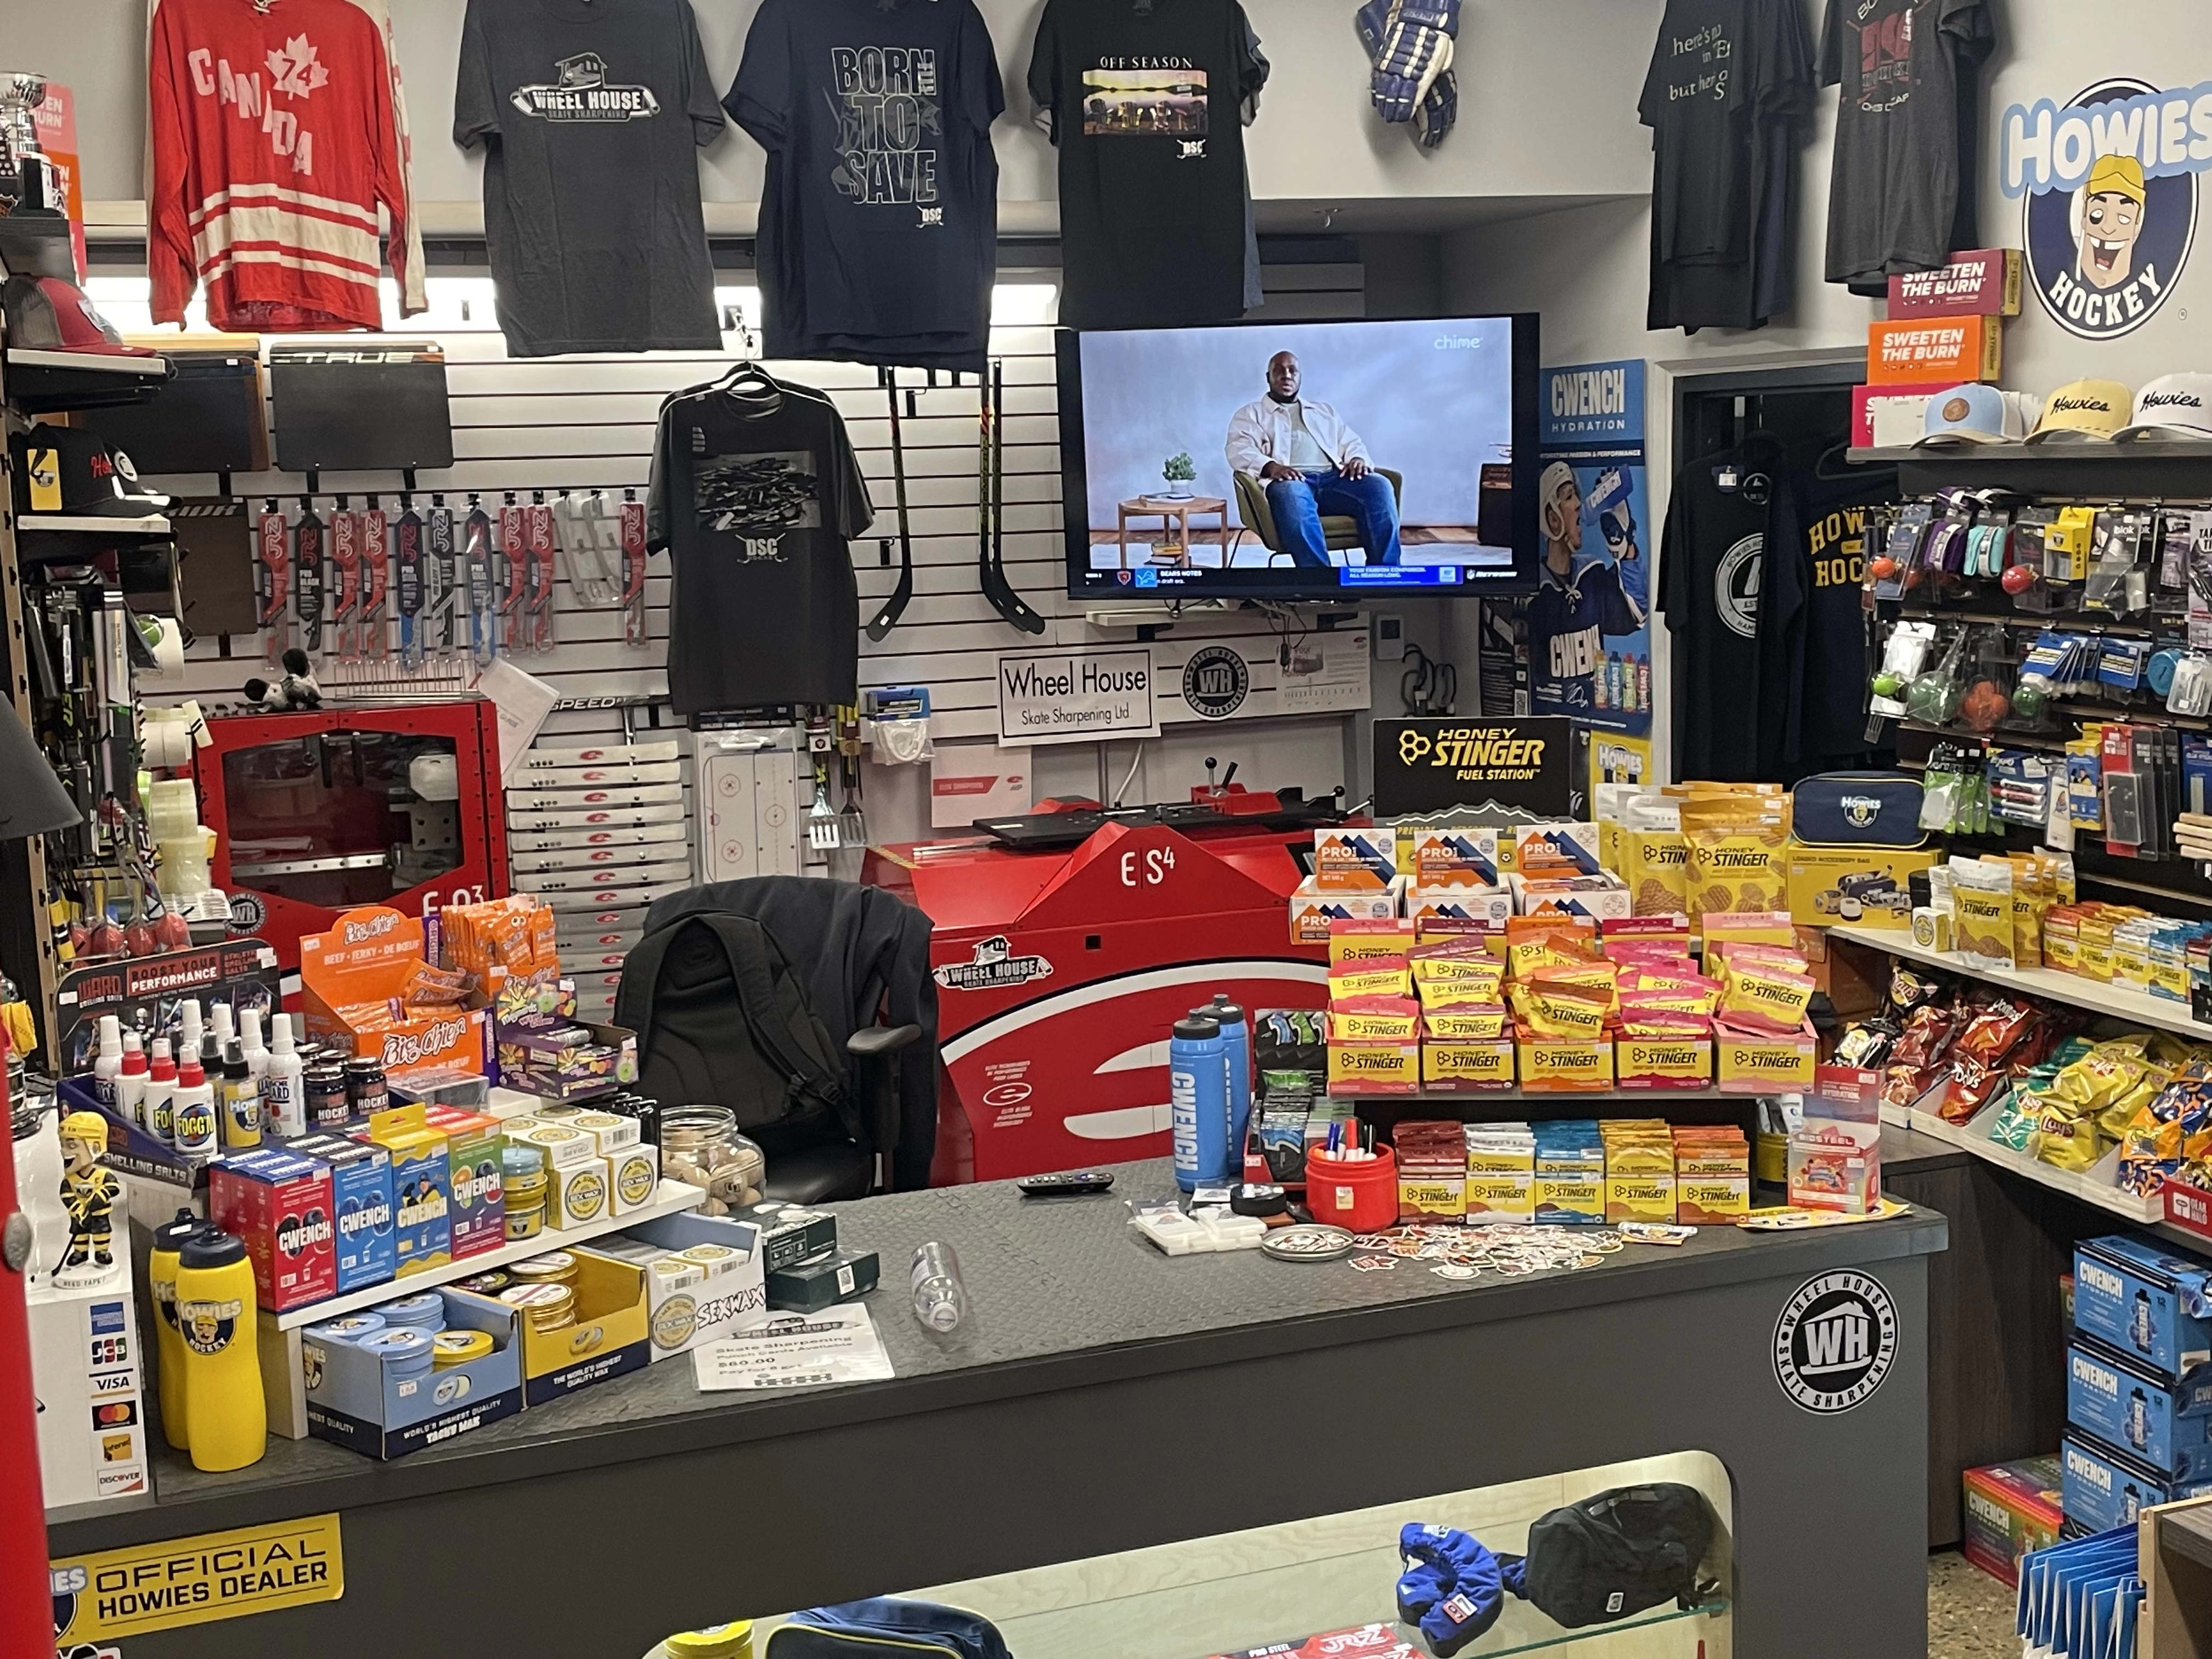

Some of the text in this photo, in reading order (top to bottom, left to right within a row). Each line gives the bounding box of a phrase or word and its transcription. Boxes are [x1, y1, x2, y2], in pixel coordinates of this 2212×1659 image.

[281, 58, 313, 86] 74
[831, 46, 936, 96] BORN
[1100, 57, 1193, 70] OFF SEASON
[532, 91, 641, 109] WHEEL HOUSE
[575, 110, 627, 119] SHARPENING
[851, 94, 919, 151] TO
[1183, 140, 1203, 154] DSC
[2010, 97, 2212, 188] HOWIES
[844, 150, 936, 205] SAVE
[922, 208, 942, 222] DSC
[1902, 278, 1982, 297] THE BURN
[2050, 263, 2163, 326] HOCKEY
[1434, 335, 1480, 350] chime
[1883, 328, 1965, 347] SWEETEN
[295, 351, 415, 364] TRUE
[1882, 345, 1961, 362] THE BURN
[1550, 368, 1625, 417] CWENCH
[2140, 392, 2202, 412] Howies
[2051, 396, 2111, 414] Howies
[1551, 419, 1625, 433] HYDRATION
[1597, 449, 1641, 458] PERFORMANCE
[365, 515, 383, 555] JRZ
[433, 514, 450, 553] JRZ
[505, 511, 522, 549] JRZ
[533, 509, 549, 548] JRZ
[625, 507, 642, 545] JRZ
[2113, 525, 2135, 535] blok
[265, 515, 283, 560] JRZ
[301, 527, 317, 566] JRZ
[335, 518, 353, 558] JRZ
[399, 523, 417, 563] JRZ
[746, 538, 778, 556] DSC
[1004, 661, 1147, 698] Wheel House
[1198, 668, 1233, 693] WH
[1022, 706, 1111, 726] Skate Sharpening
[1437, 727, 1517, 740] HONEY
[1431, 741, 1545, 766] STINGER
[1599, 745, 1642, 772] HOWIES
[1456, 769, 1534, 780] FUEL STATION
[1841, 797, 1882, 810] HOWIES
[1321, 847, 1352, 857] PRO
[1421, 848, 1453, 857] PRO
[1524, 843, 1556, 854] PRO
[1712, 853, 1769, 867] STINGER
[232, 905, 256, 922] WH
[1962, 906, 2000, 917] STINGER
[1301, 916, 1330, 927] PRO
[344, 922, 369, 945] Big
[324, 952, 346, 966] BEEF
[352, 949, 377, 960] JERKY
[383, 944, 395, 954] DE
[131, 965, 176, 981] BOOST
[181, 957, 217, 971] YOUR
[950, 959, 1036, 981] WHEEL HOUSE
[78, 975, 123, 1000] WARD
[131, 967, 218, 992] PERFORMANCE
[1356, 975, 1400, 988] STINGER
[1444, 983, 1492, 993] STINGER
[1754, 986, 1803, 1007] STINGER
[1551, 1008, 1599, 1026] STINGER
[1361, 1025, 1408, 1035] STINGER
[1450, 1023, 1497, 1034] STINGER
[382, 1034, 422, 1069] Big
[420, 1017, 467, 1056] Chief
[1355, 1058, 1404, 1069] STINGER
[1449, 1056, 1500, 1068] STINGER
[1549, 1055, 1599, 1068] STINGER
[1647, 1051, 1697, 1065] STINGER
[1750, 1056, 1801, 1069] STINGER
[1172, 1071, 1199, 1171] CWENCH
[1798, 1133, 1853, 1145] BIOSTEEL
[103, 1153, 153, 1177] SMELLING
[154, 1164, 187, 1182] SALTS
[454, 1173, 501, 1201] CWENCH
[636, 1176, 651, 1185] WAX
[569, 1190, 601, 1202] SEX WAX
[1486, 1189, 1526, 1199] STINGER
[1556, 1187, 1596, 1198] STINGER
[1626, 1189, 1667, 1199] STINGER
[1700, 1192, 1740, 1201] STINGER
[340, 1204, 390, 1235] CWENCH
[398, 1197, 448, 1229] CWENCH
[278, 1220, 331, 1254] CWENCH
[2079, 1261, 2123, 1299] CWENCH
[177, 1300, 242, 1322] HOWIES
[696, 1283, 766, 1330] SEXWAX
[1784, 1276, 1888, 1328] WHEEL HOUSE
[2157, 1296, 2166, 1307] 12
[189, 1337, 228, 1352] HOCKEY
[716, 1337, 853, 1353] Skate Sharpening
[1804, 1315, 1869, 1365] WH
[93, 1345, 126, 1358] JCB
[554, 1355, 622, 1385] THE WORLD'S HIGHEST
[567, 1366, 609, 1387] QUALITY WAX
[1779, 1331, 1893, 1408] SKATE SHARPENING
[2073, 1356, 2118, 1395] CWENCH
[97, 1376, 130, 1391] VISA
[2153, 1395, 2163, 1406] 12
[326, 1418, 354, 1435] QUALITY
[404, 1399, 501, 1439] WORLD'S HIGHEST QUALITY
[459, 1415, 481, 1433] WAX
[100, 1472, 140, 1485] DISCOVER
[2067, 1449, 2112, 1491] CWENCH
[1968, 1491, 2010, 1530] CWENCH
[97, 1538, 326, 1593] OFFICIAL
[98, 1561, 328, 1619] HOWIES DEALER
[1319, 1629, 1388, 1652] JRZ
[1249, 1644, 1291, 1658] PRO STEEL
